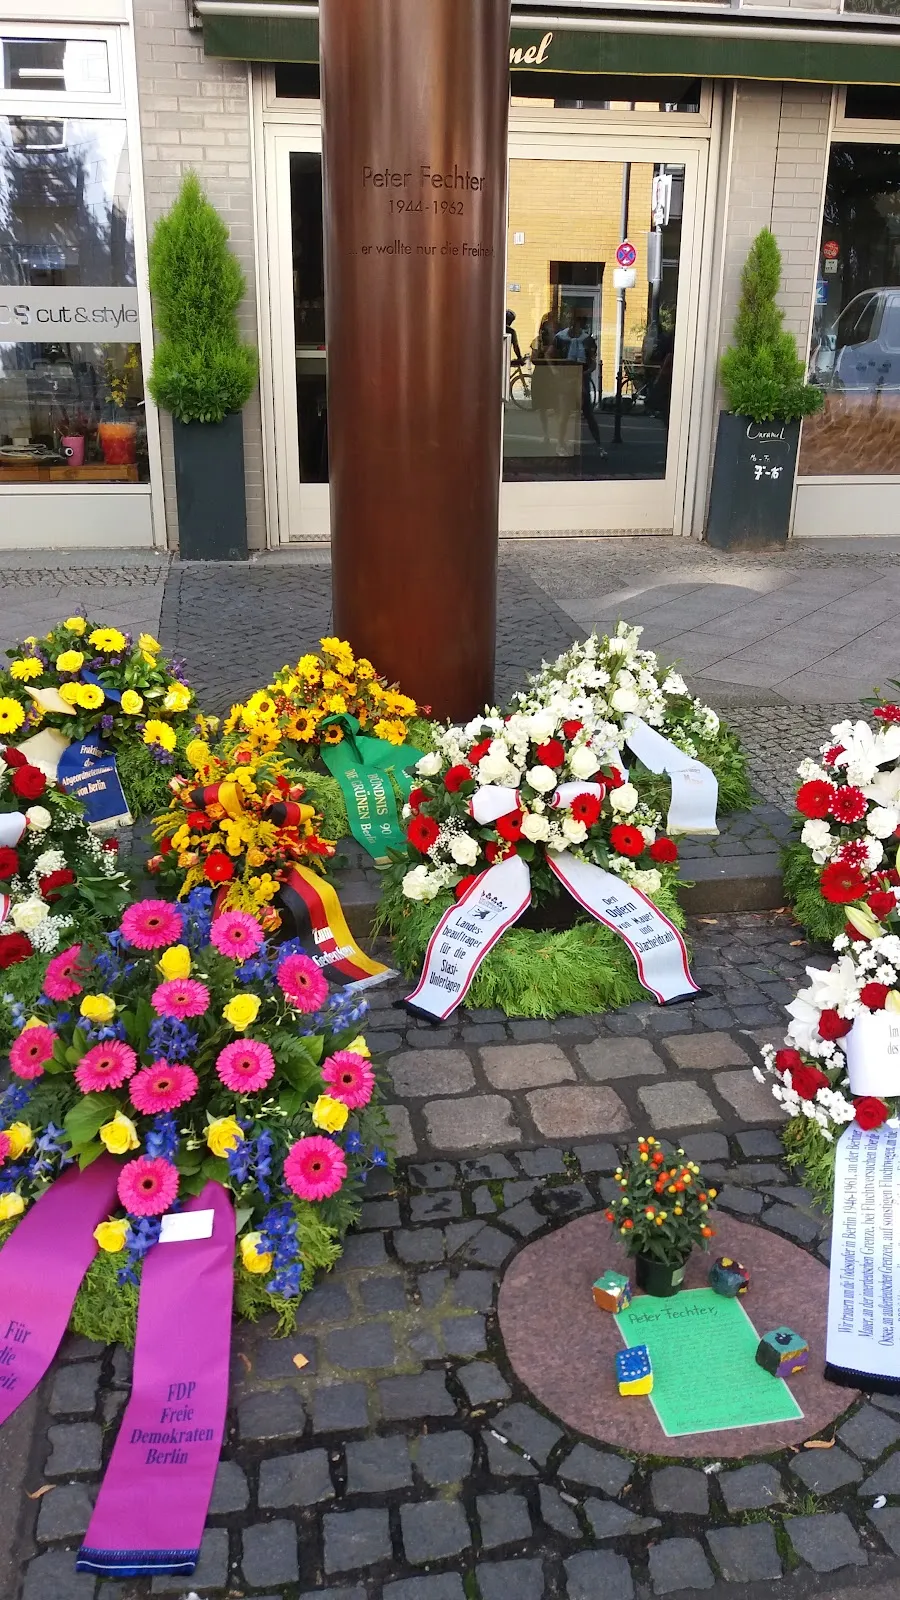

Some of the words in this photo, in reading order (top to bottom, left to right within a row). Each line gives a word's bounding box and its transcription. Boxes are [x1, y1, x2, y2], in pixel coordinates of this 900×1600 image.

[362, 166, 412, 187] Peter
[420, 164, 485, 191] Fechter
[361, 246, 373, 254] er
[376, 239, 412, 255] wollte
[417, 245, 437, 255] nur
[441, 241, 459, 256] die
[88, 779, 107, 793] Berlin
[367, 773, 389, 816] BÜNDNIS
[351, 780, 370, 820] GRÜNEN
[601, 895, 619, 905] Den
[605, 902, 638, 918] Opfern
[455, 916, 484, 934] Landes-
[616, 921, 632, 930] von
[631, 911, 655, 925] Mauer
[639, 924, 654, 935] und
[634, 930, 676, 953] Stacheldraht
[440, 942, 451, 955] für
[453, 947, 467, 960] die
[440, 959, 458, 976] Stasi-
[429, 971, 461, 993] Unterlagen
[889, 1024, 899, 1038] Im
[846, 1129, 863, 1150] Berliner
[864, 1139, 879, 1151] über
[845, 1151, 859, 1163] der
[847, 1164, 858, 1173] an
[861, 1151, 877, 1211] Fluchtversuchen
[879, 1190, 895, 1227] sonstigen
[861, 1213, 875, 1225] bei
[842, 1217, 856, 1240] Berlin
[879, 1226, 893, 1241] auf
[842, 1240, 855, 1248] in
[840, 1247, 859, 1280] Todesopfer
[840, 1280, 855, 1289] die
[859, 1256, 874, 1297] innerdeutschen
[841, 1299, 854, 1321] trauern
[859, 1297, 873, 1308] der
[628, 1312, 661, 1325] Peter
[660, 1304, 718, 1319] Fechter,
[862, 1309, 873, 1318] an
[882, 1317, 893, 1326] an
[4, 1319, 31, 1344] Für
[838, 1321, 854, 1333] Wir
[858, 1318, 875, 1339] Mauer,
[878, 1326, 895, 1347] Ostsee,
[167, 1381, 196, 1402] FDP
[160, 1404, 194, 1424] Freie
[130, 1427, 213, 1444] Demokraten
[145, 1448, 188, 1464] Berlin
